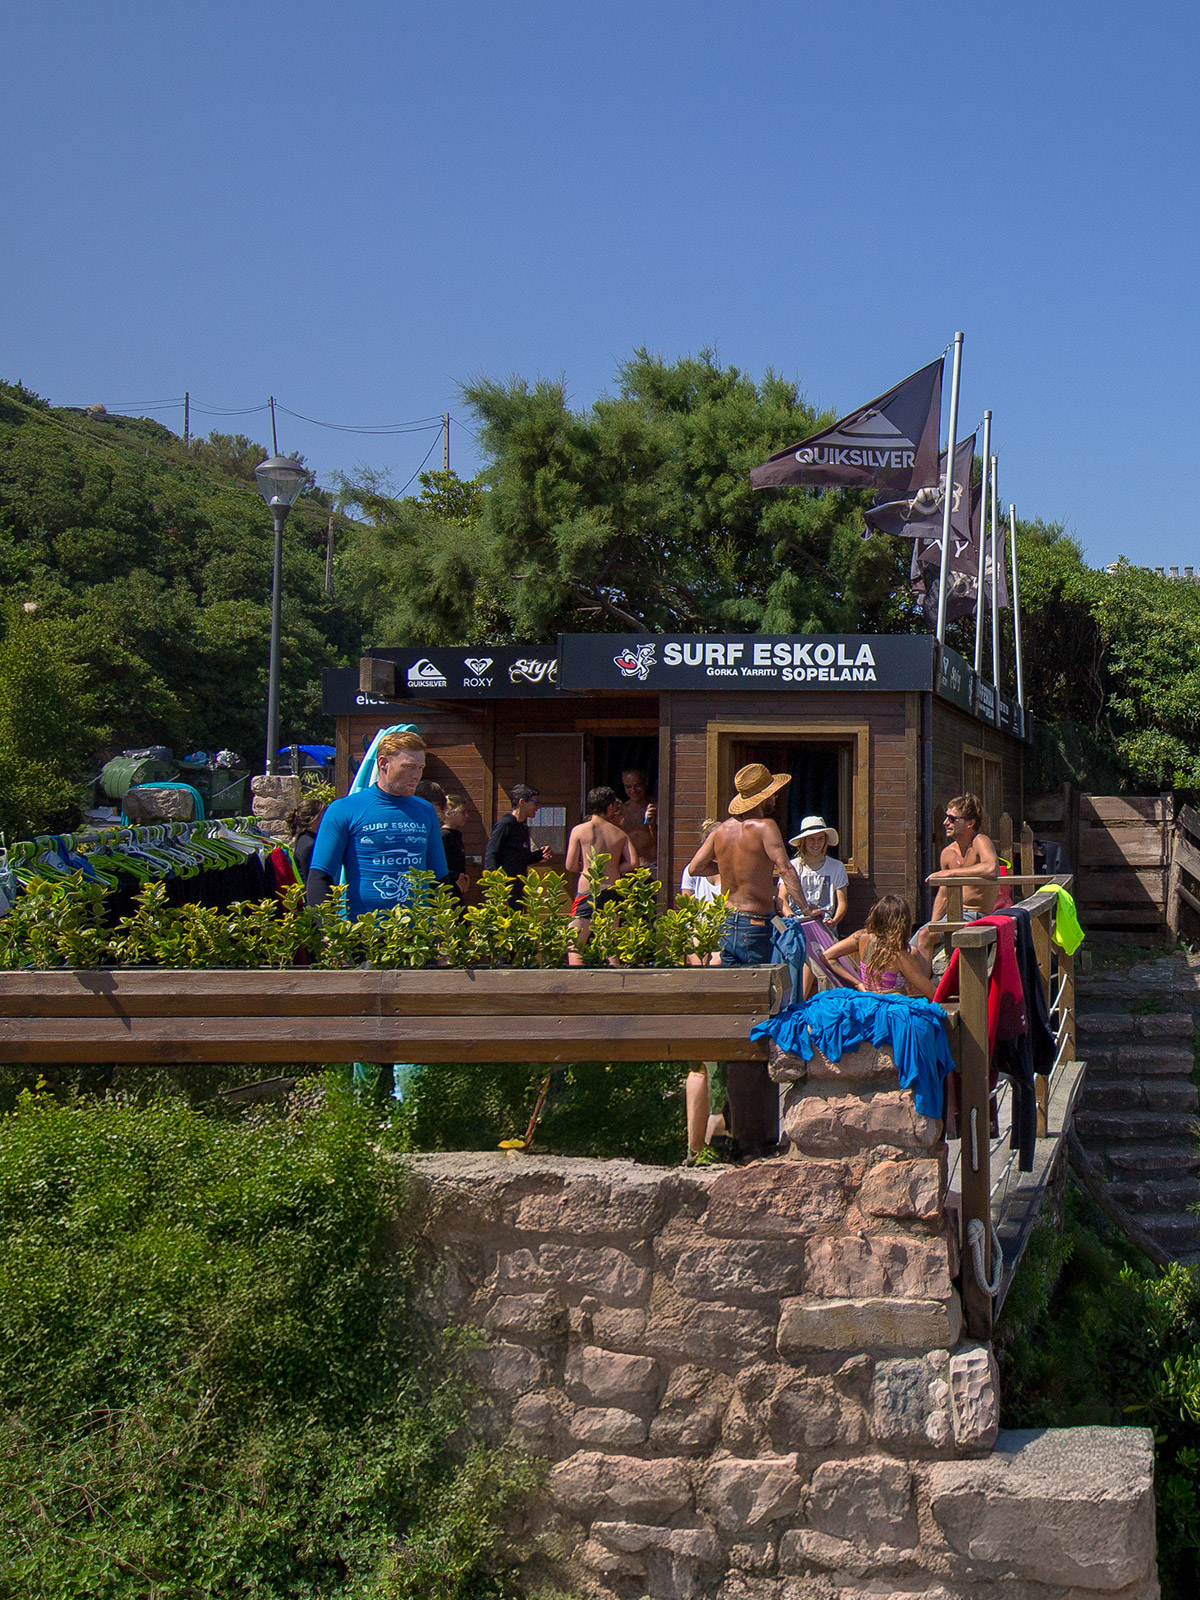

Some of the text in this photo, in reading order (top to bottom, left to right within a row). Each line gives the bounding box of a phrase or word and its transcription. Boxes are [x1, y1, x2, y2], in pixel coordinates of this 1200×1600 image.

[795, 447, 916, 468] QUIKSILVER
[663, 642, 876, 666] SURF ESKOLA
[781, 667, 877, 681] SOPELANA
[407, 680, 447, 688] QUIKSILVER
[463, 677, 494, 687] ROXY
[362, 822, 389, 832] SURF
[372, 855, 422, 865] elecnor
